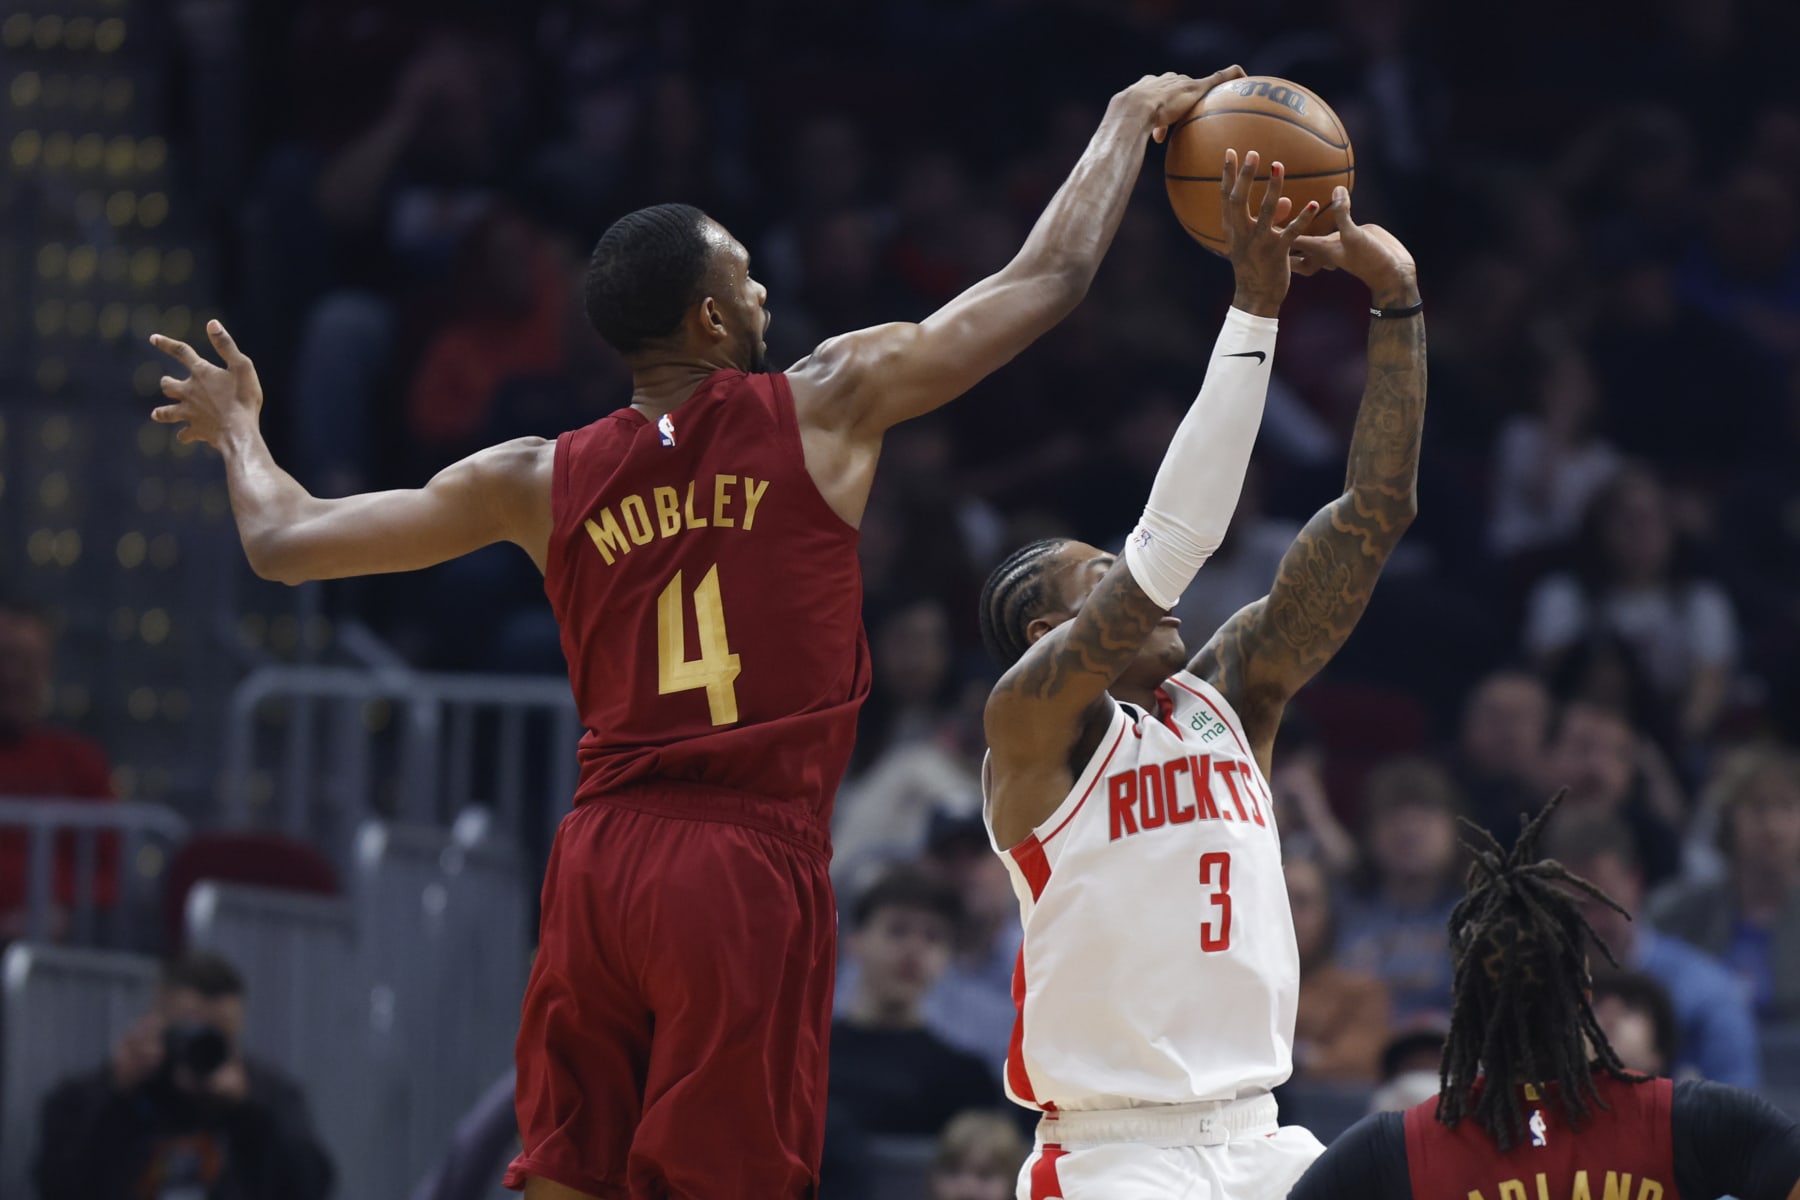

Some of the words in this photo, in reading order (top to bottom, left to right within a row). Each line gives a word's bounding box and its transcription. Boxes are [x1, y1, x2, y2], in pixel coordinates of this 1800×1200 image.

[583, 473, 770, 566] MOBLEY
[657, 561, 742, 726] 4
[1108, 753, 1266, 841] ROCKTS
[1199, 851, 1231, 953] 3
